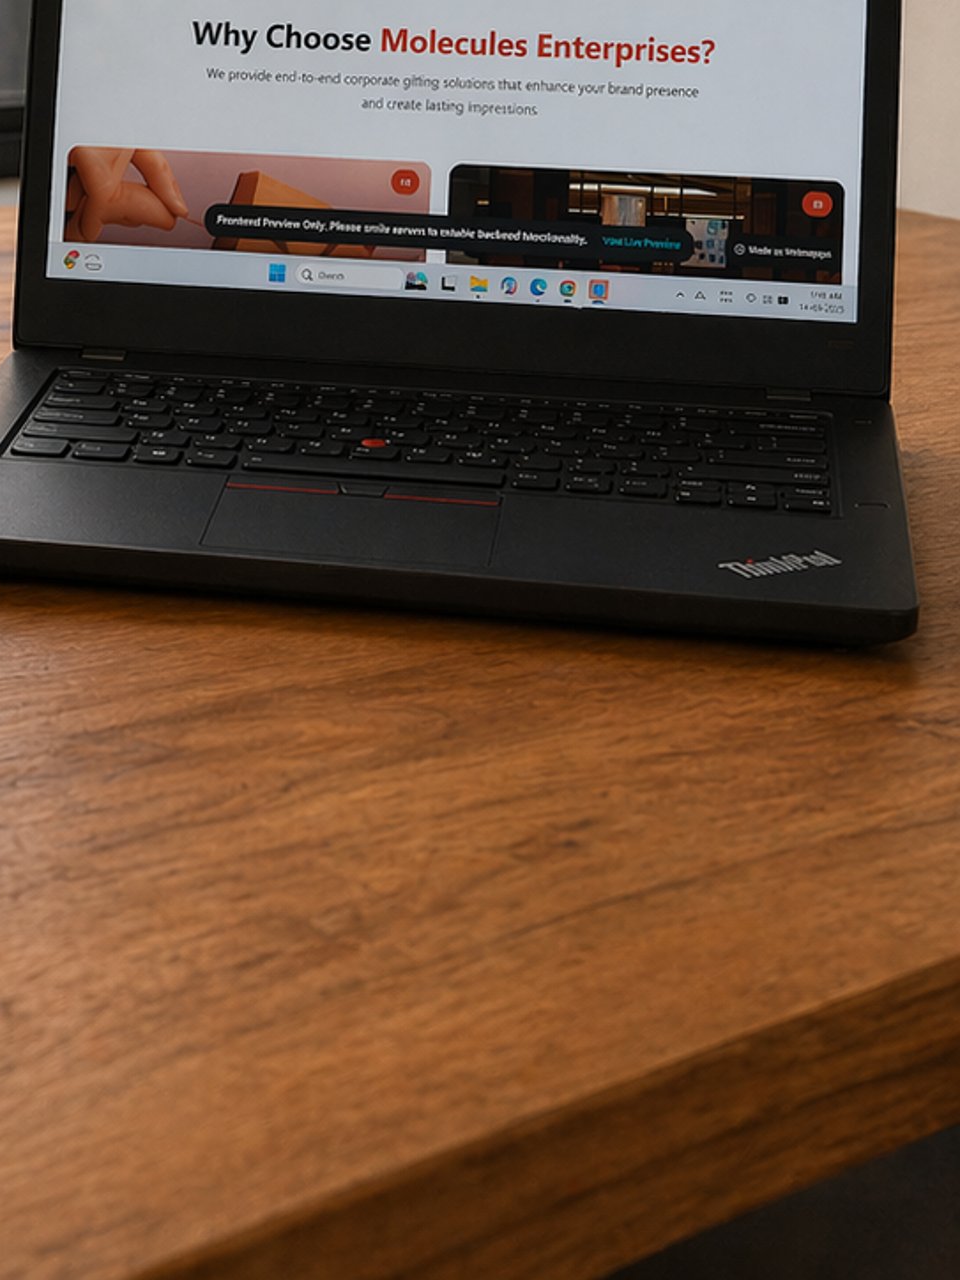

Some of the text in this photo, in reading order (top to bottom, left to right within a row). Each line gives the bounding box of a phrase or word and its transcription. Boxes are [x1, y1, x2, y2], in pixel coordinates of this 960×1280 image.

[192, 21, 716, 68] Why Choose Molecules Enterprises?
[206, 68, 225, 79] We
[228, 68, 273, 83] provide
[275, 71, 341, 84] end-to-end
[343, 73, 400, 88] corporate
[443, 78, 495, 90] solutions
[498, 79, 522, 91] that
[525, 81, 576, 93] enhance
[577, 84, 606, 96] your
[608, 82, 643, 95] brand
[645, 86, 699, 99] presence
[361, 98, 384, 109] and
[386, 99, 422, 111] create
[425, 99, 464, 114] lasting
